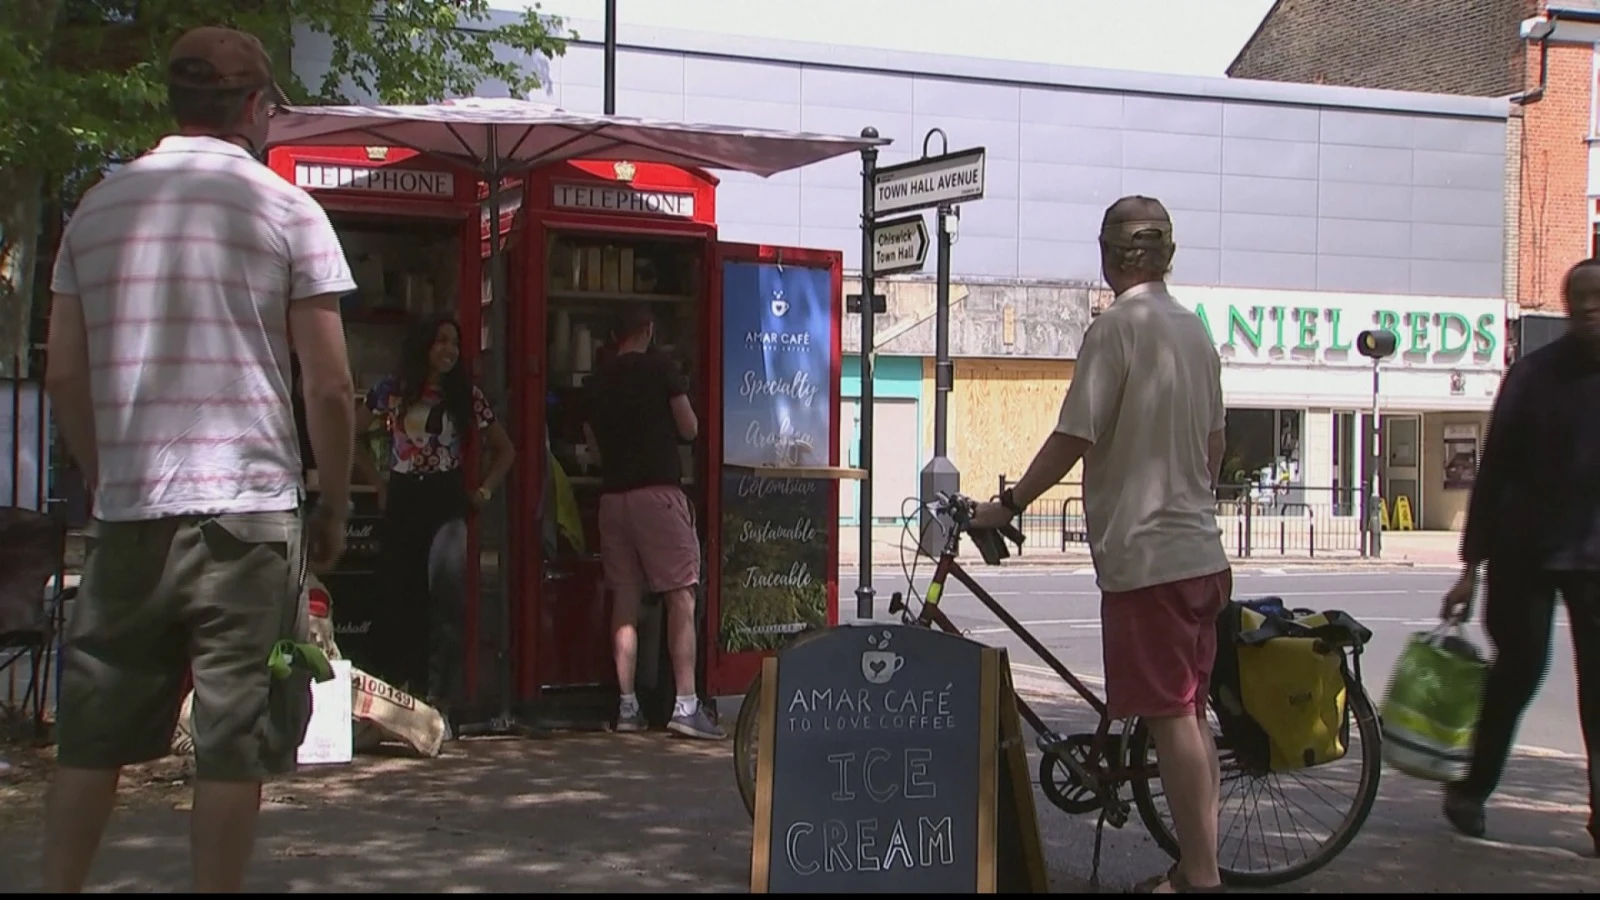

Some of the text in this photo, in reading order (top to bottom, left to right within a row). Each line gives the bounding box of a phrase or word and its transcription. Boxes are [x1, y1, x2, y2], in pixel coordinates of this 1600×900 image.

[303, 165, 447, 194] TELEPHONE
[879, 168, 979, 200] TOWN HALL AVENUE
[560, 187, 687, 213] TELEPHONE
[878, 228, 912, 247] Chiswick
[876, 246, 914, 264] Town Hall
[745, 331, 810, 345] AMAR CAFÉ
[1195, 302, 1497, 355] ANIEL BEDS
[739, 370, 819, 408] Specialty
[740, 517, 816, 543] Sustainable
[743, 561, 812, 588] Traceable
[368, 680, 411, 706] 00149
[788, 683, 953, 715] AMAR CAFÉ
[788, 715, 956, 732] TO LOVE COFFEE
[828, 747, 937, 802] ICE
[786, 816, 954, 875] CREAM
